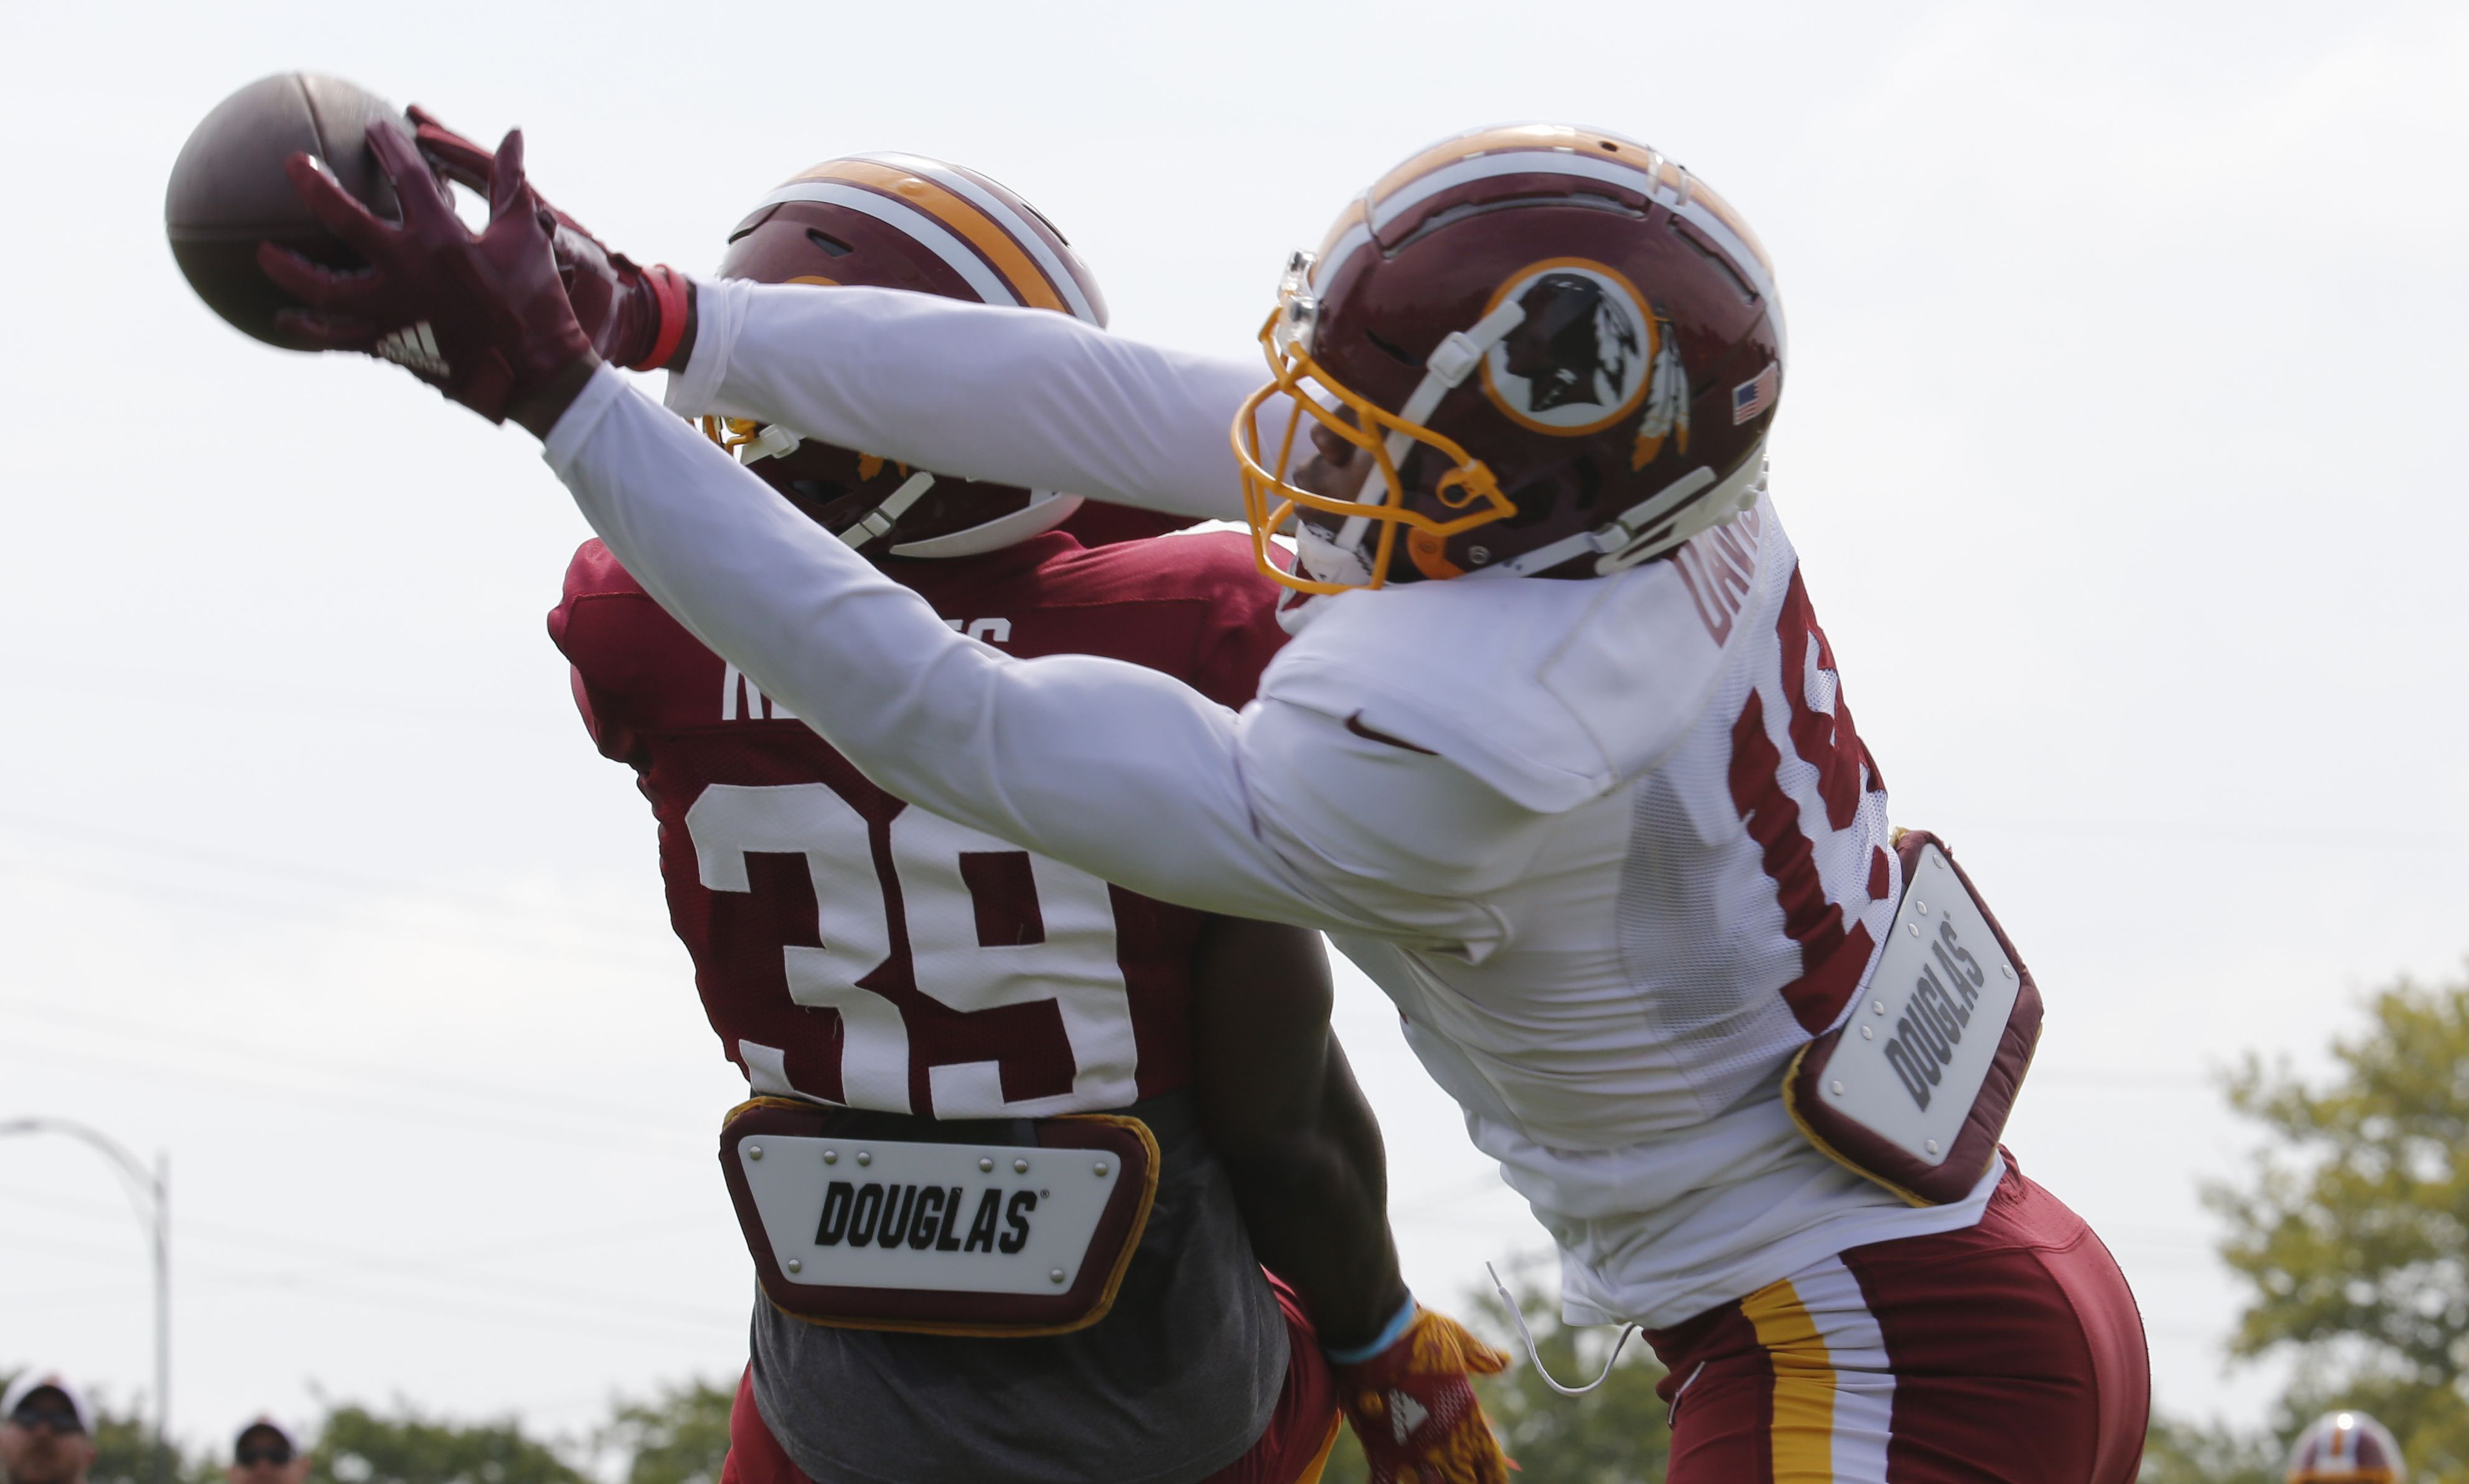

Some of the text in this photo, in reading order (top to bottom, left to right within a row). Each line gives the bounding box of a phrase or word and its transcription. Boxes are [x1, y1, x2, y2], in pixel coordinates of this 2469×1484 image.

[685, 782, 1139, 1121] 39
[1884, 921, 1985, 1112] DOUGLAS
[814, 1181, 1038, 1253] DOUGLAS
